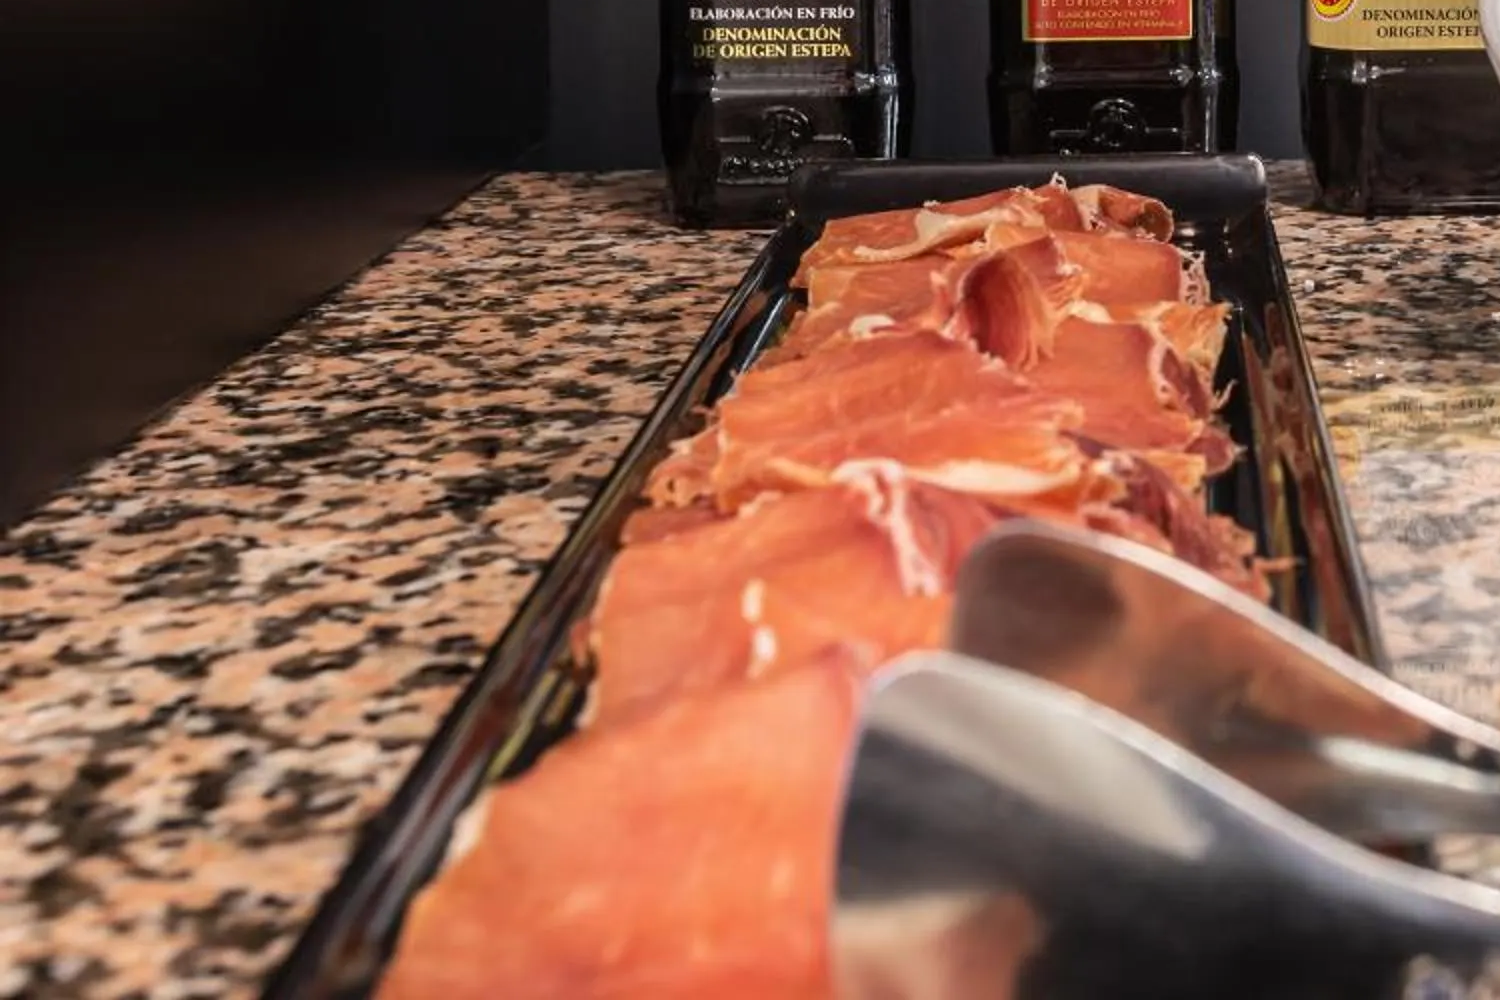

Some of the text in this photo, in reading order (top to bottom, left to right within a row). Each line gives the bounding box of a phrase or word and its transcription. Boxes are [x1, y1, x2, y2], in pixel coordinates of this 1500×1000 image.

[691, 4, 856, 21] ELABORACIÓN EN FRÍO
[703, 23, 842, 41] DENOMINACIÓN
[1376, 25, 1479, 38] ORIGEN ESTE
[692, 43, 852, 59] DE ORIGEN ESTEPA
